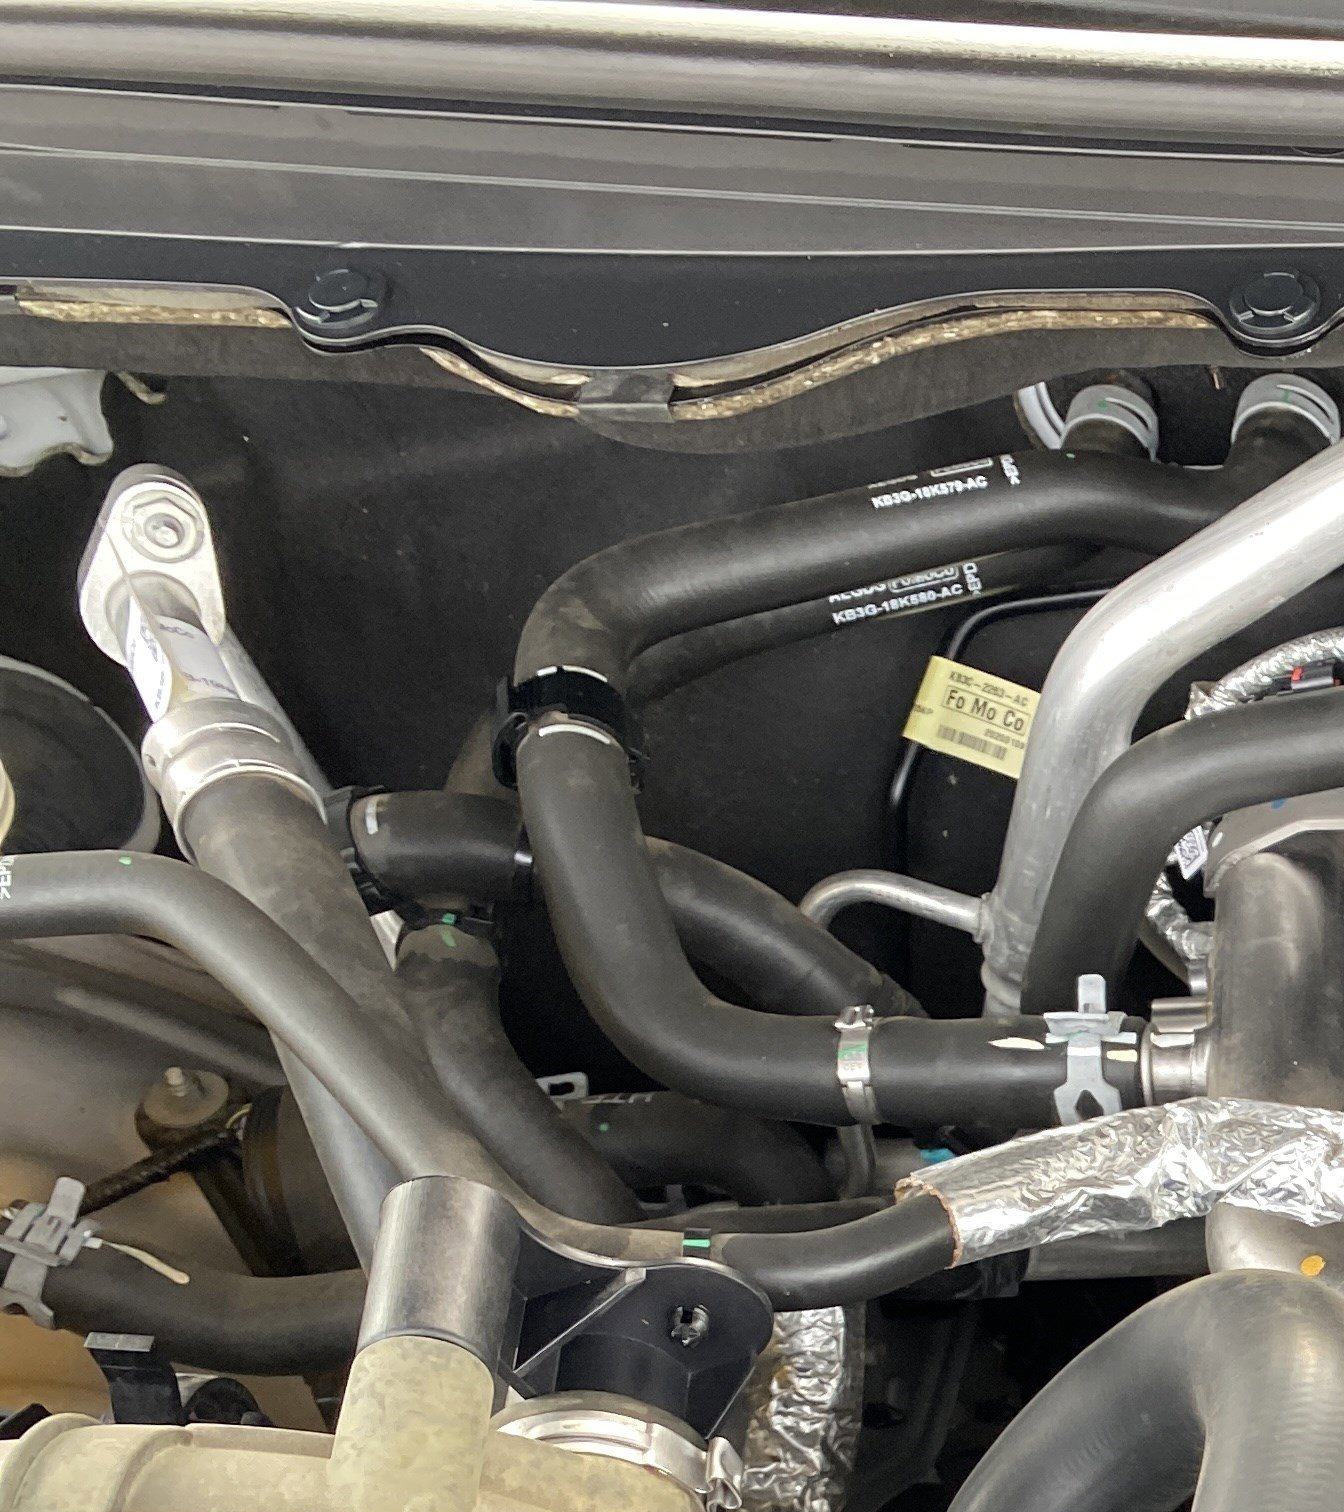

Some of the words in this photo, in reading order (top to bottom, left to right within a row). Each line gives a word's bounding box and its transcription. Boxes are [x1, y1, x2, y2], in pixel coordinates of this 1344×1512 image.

[946, 689, 966, 709] Fo
[970, 698, 997, 720] Mo
[1003, 710, 1025, 731] Co
